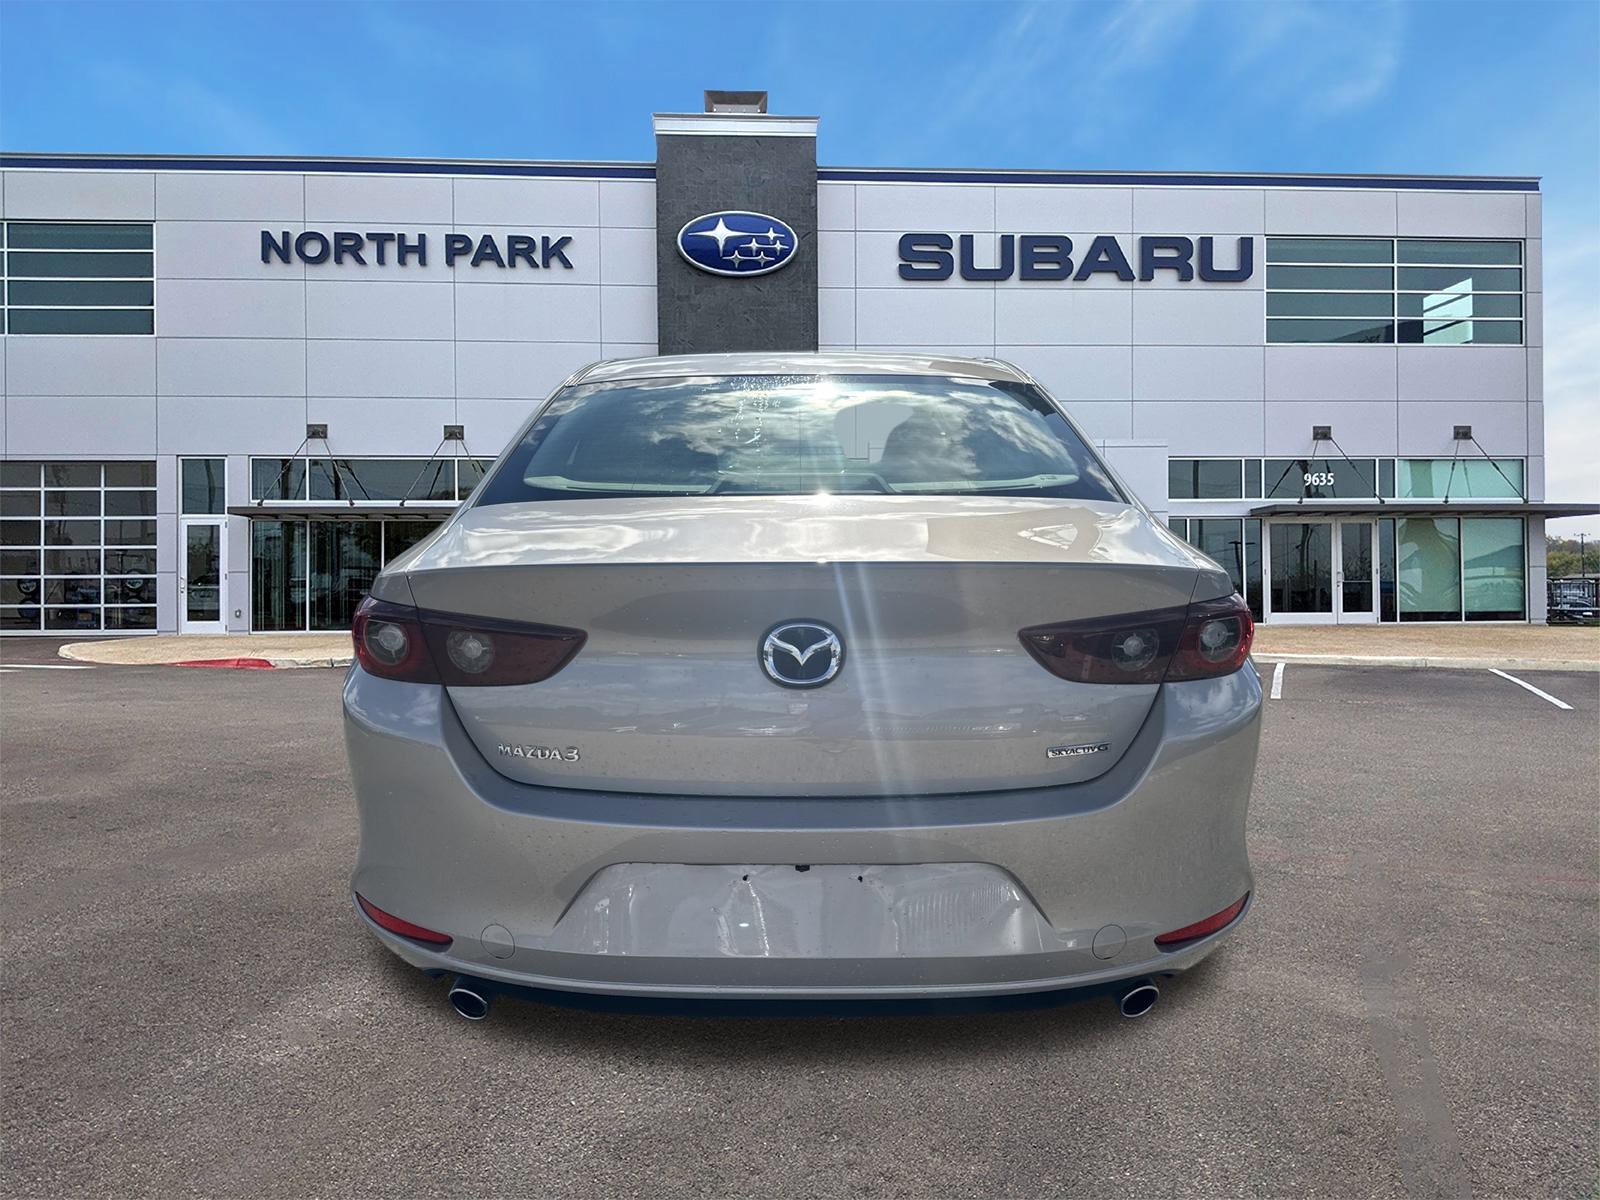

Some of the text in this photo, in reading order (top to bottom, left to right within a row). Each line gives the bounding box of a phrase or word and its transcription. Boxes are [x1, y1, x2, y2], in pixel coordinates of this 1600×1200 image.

[260, 230, 574, 269] NORTH PARK
[898, 233, 1254, 282] SUBARU
[1303, 472, 1335, 486] 9635
